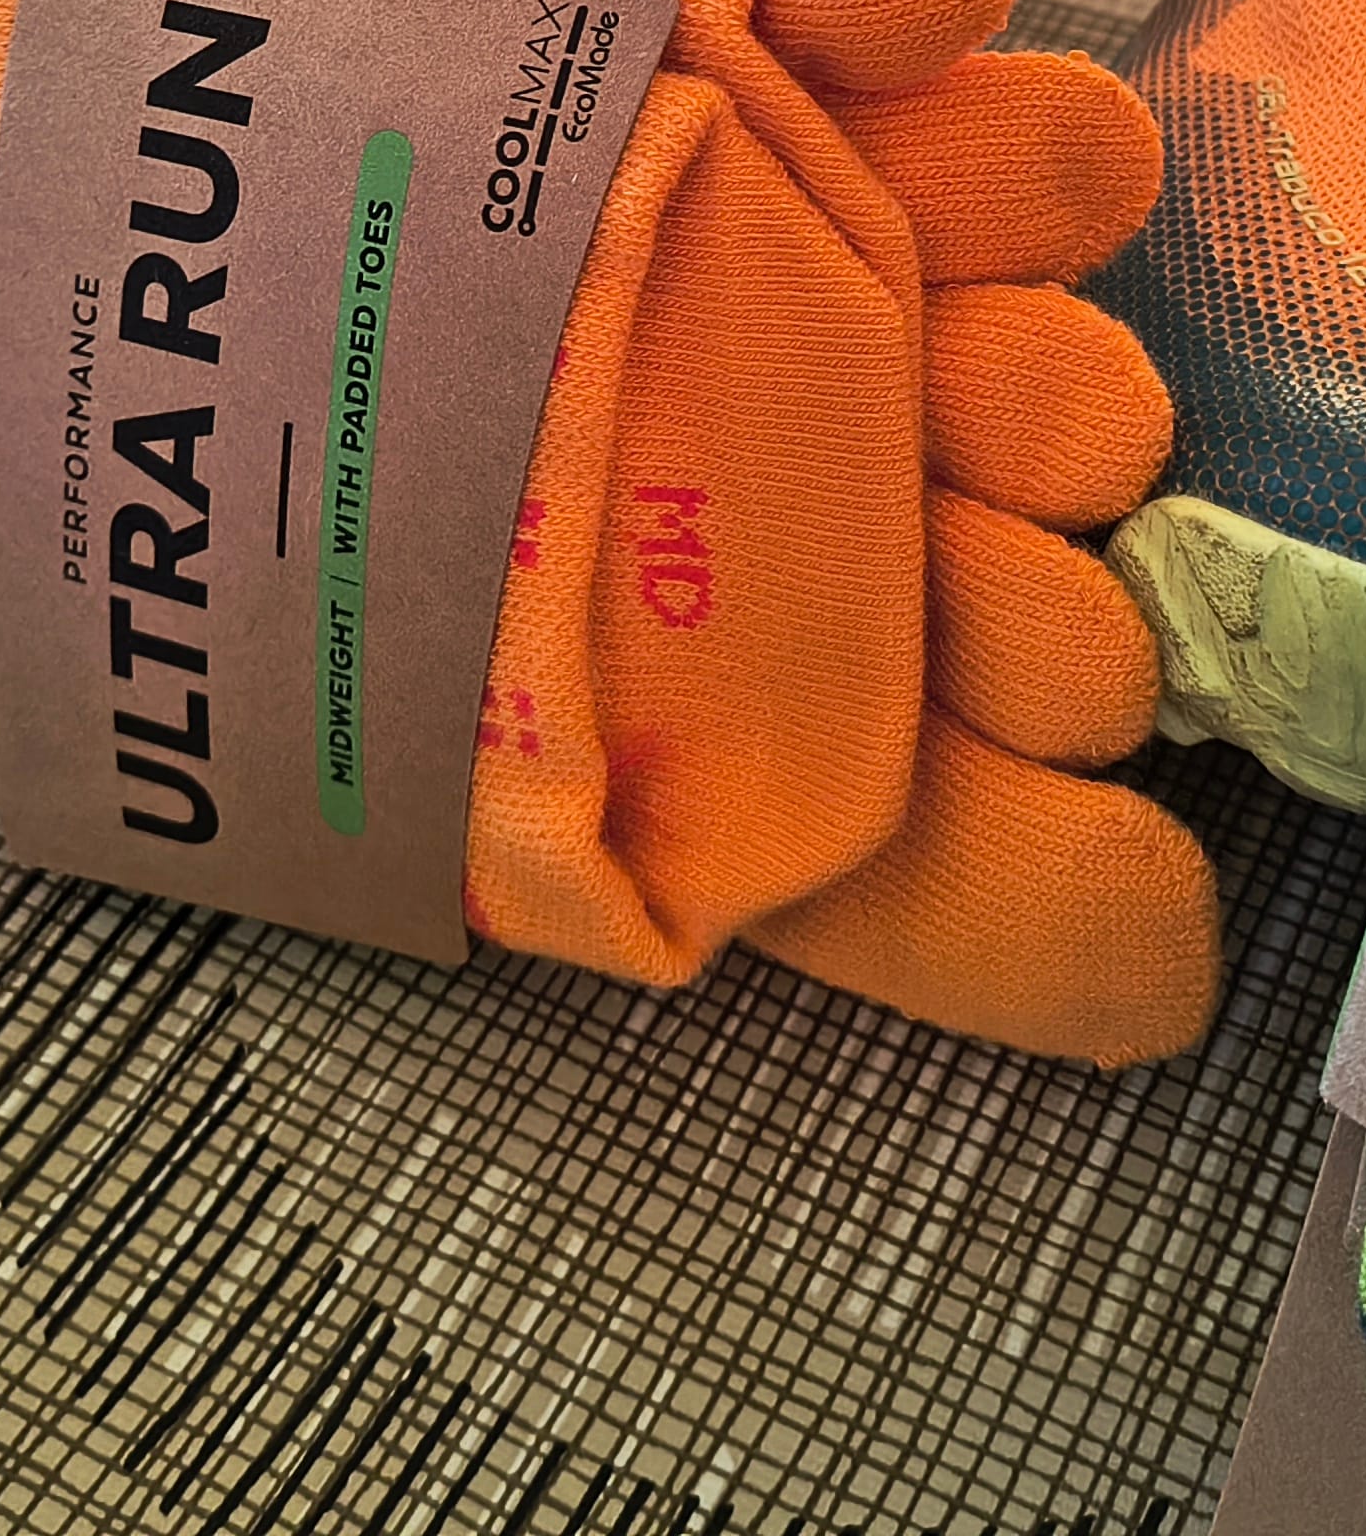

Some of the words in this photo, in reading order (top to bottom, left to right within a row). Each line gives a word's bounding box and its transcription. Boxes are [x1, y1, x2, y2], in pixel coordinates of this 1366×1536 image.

[562, 11, 620, 142] EcoMade
[355, 199, 394, 292] TOES
[63, 274, 100, 584] PERFORMANCE
[339, 304, 378, 454] PADDED
[333, 465, 362, 555] WITH
[110, 406, 219, 845] ULTRA
[330, 601, 356, 786] MIDWEIGHT
